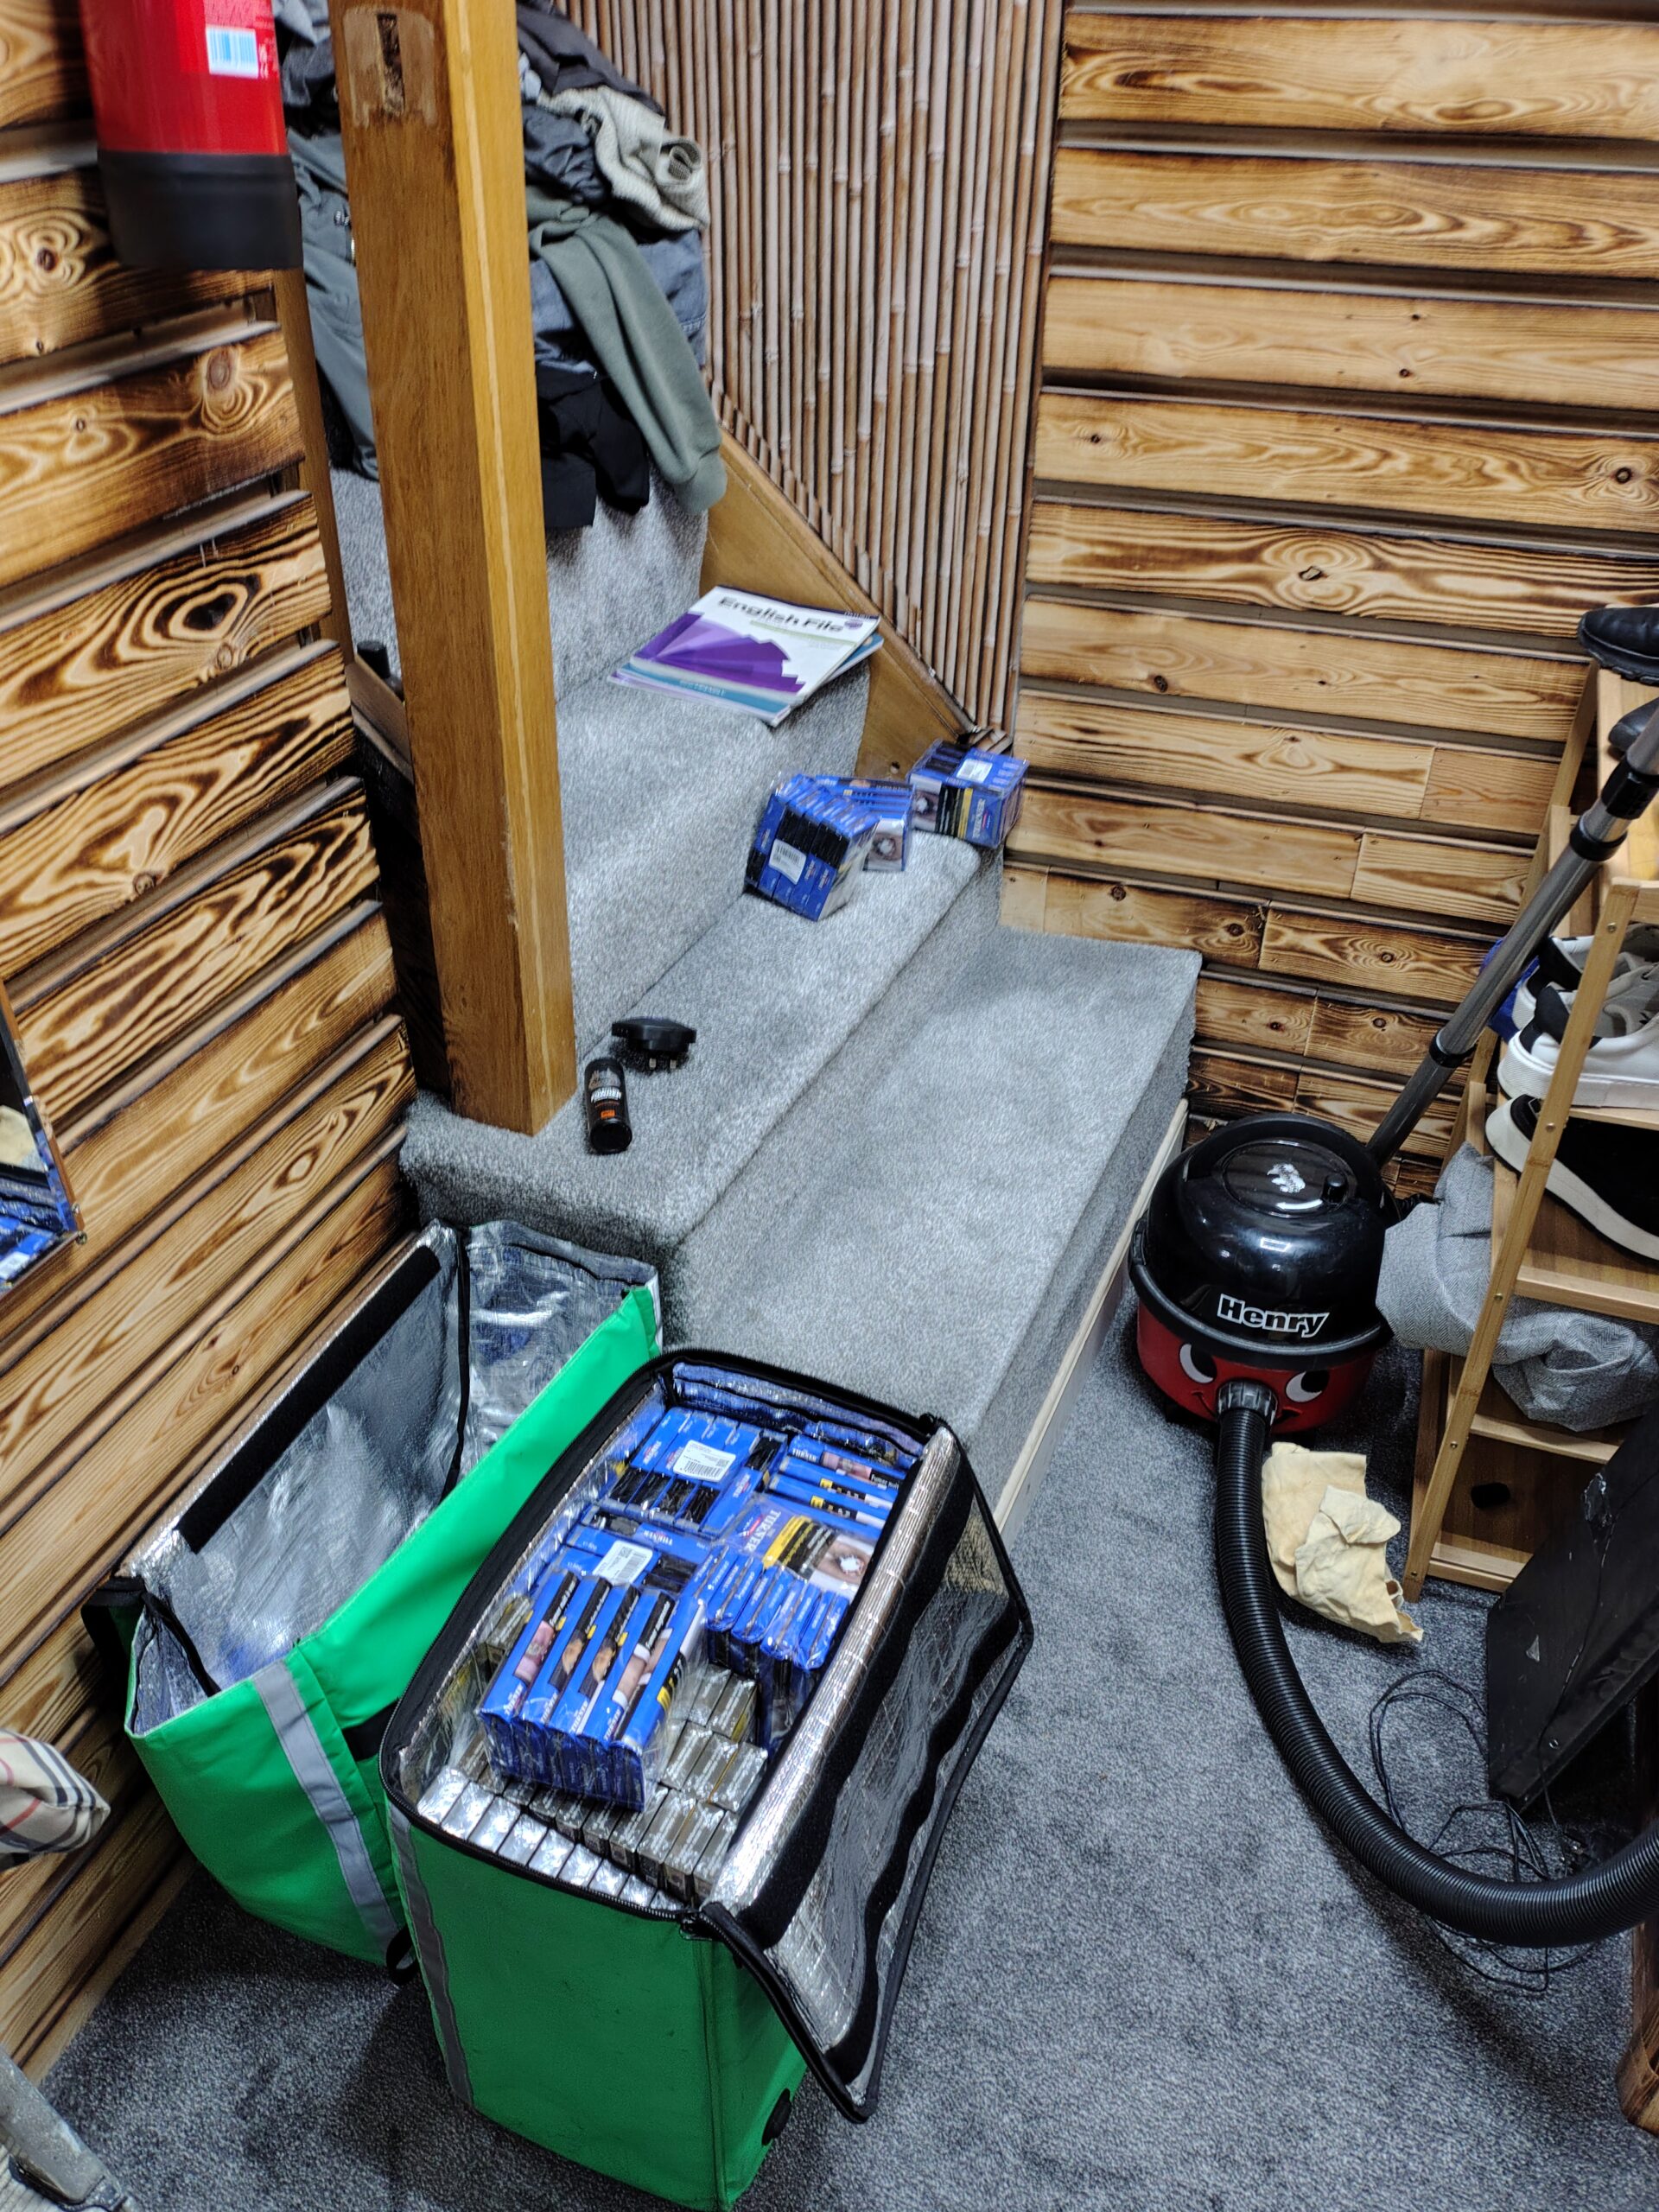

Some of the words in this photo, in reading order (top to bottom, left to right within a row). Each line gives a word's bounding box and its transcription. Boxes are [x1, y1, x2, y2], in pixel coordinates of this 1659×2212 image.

[719, 596, 799, 625] English
[803, 617, 844, 632] File
[1217, 1294, 1330, 1338] Henry
[744, 1510, 782, 1552] TURNER
